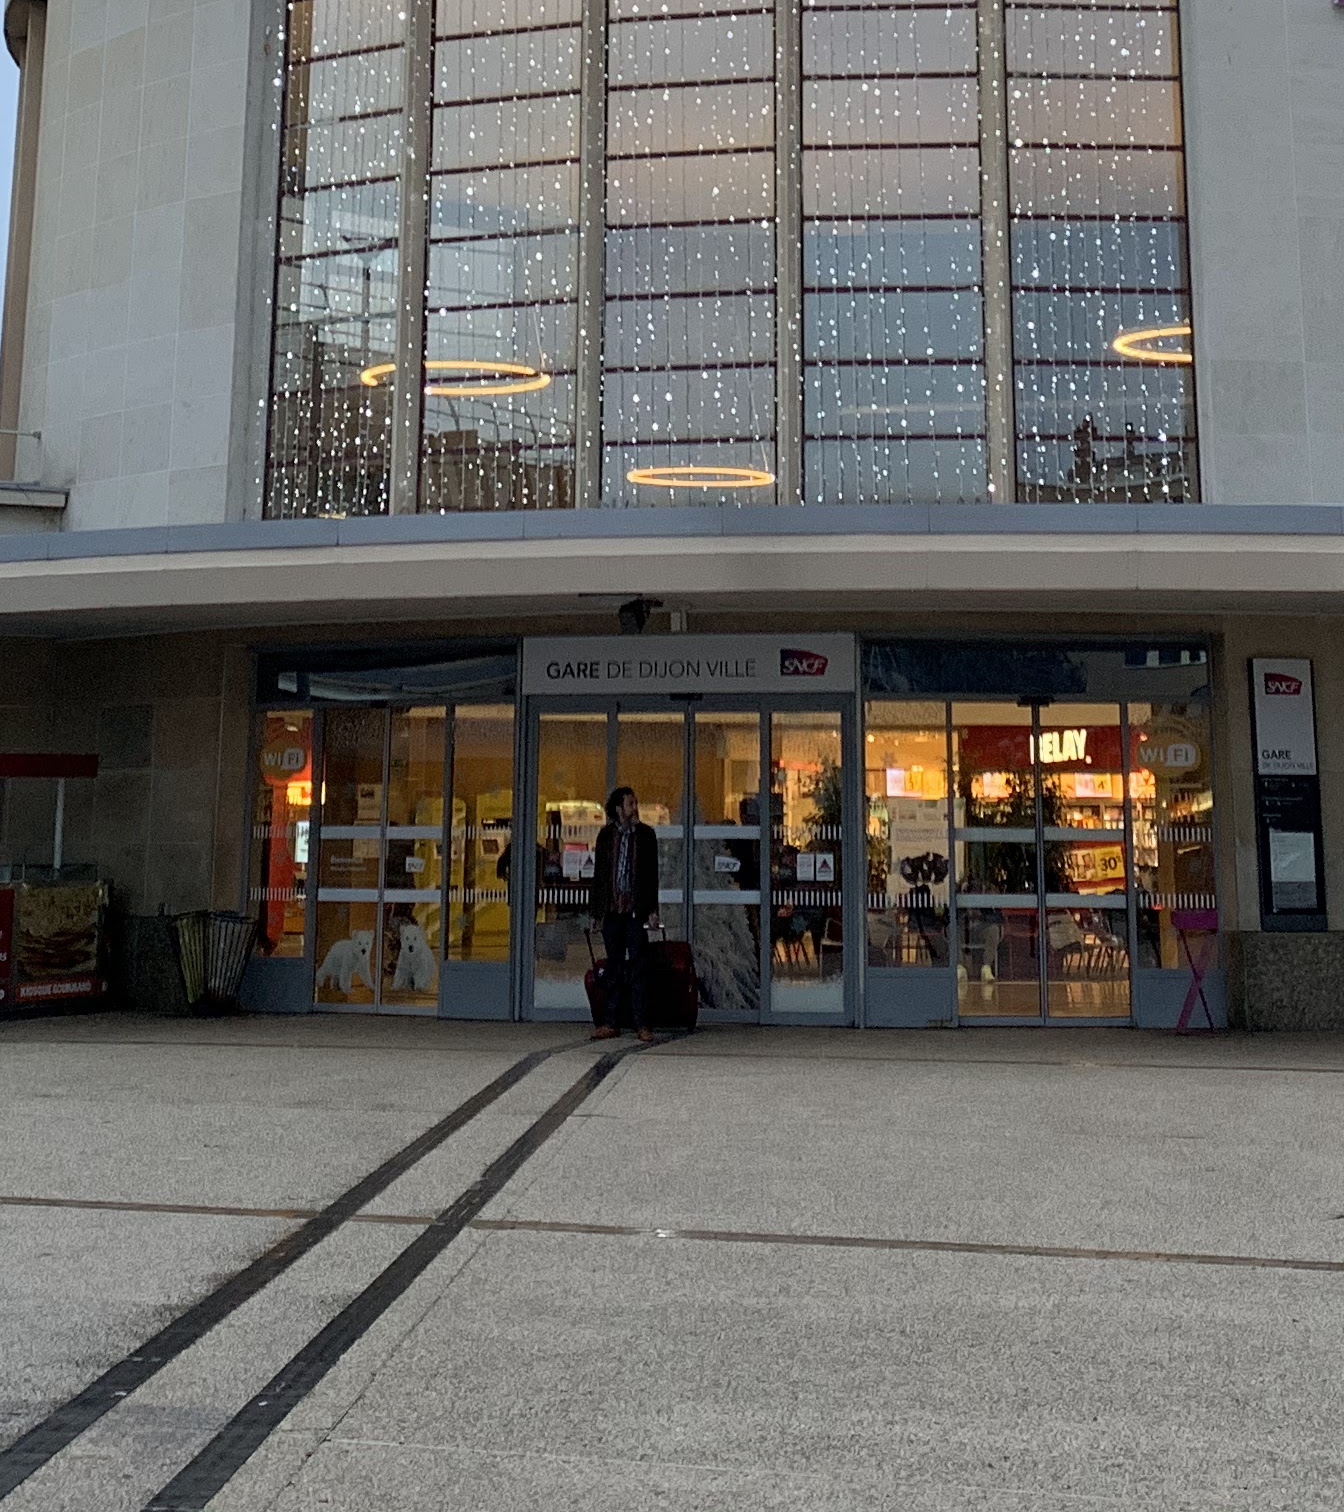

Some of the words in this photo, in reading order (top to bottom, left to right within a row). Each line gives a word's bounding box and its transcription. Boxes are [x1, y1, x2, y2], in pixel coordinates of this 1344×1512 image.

[546, 661, 601, 680] GARE
[607, 661, 633, 679] DE
[639, 659, 701, 679] DIJON
[706, 657, 757, 678] VILLE
[782, 657, 828, 675] SNCF
[1266, 680, 1301, 694] SNCF
[1261, 749, 1292, 760] GARE
